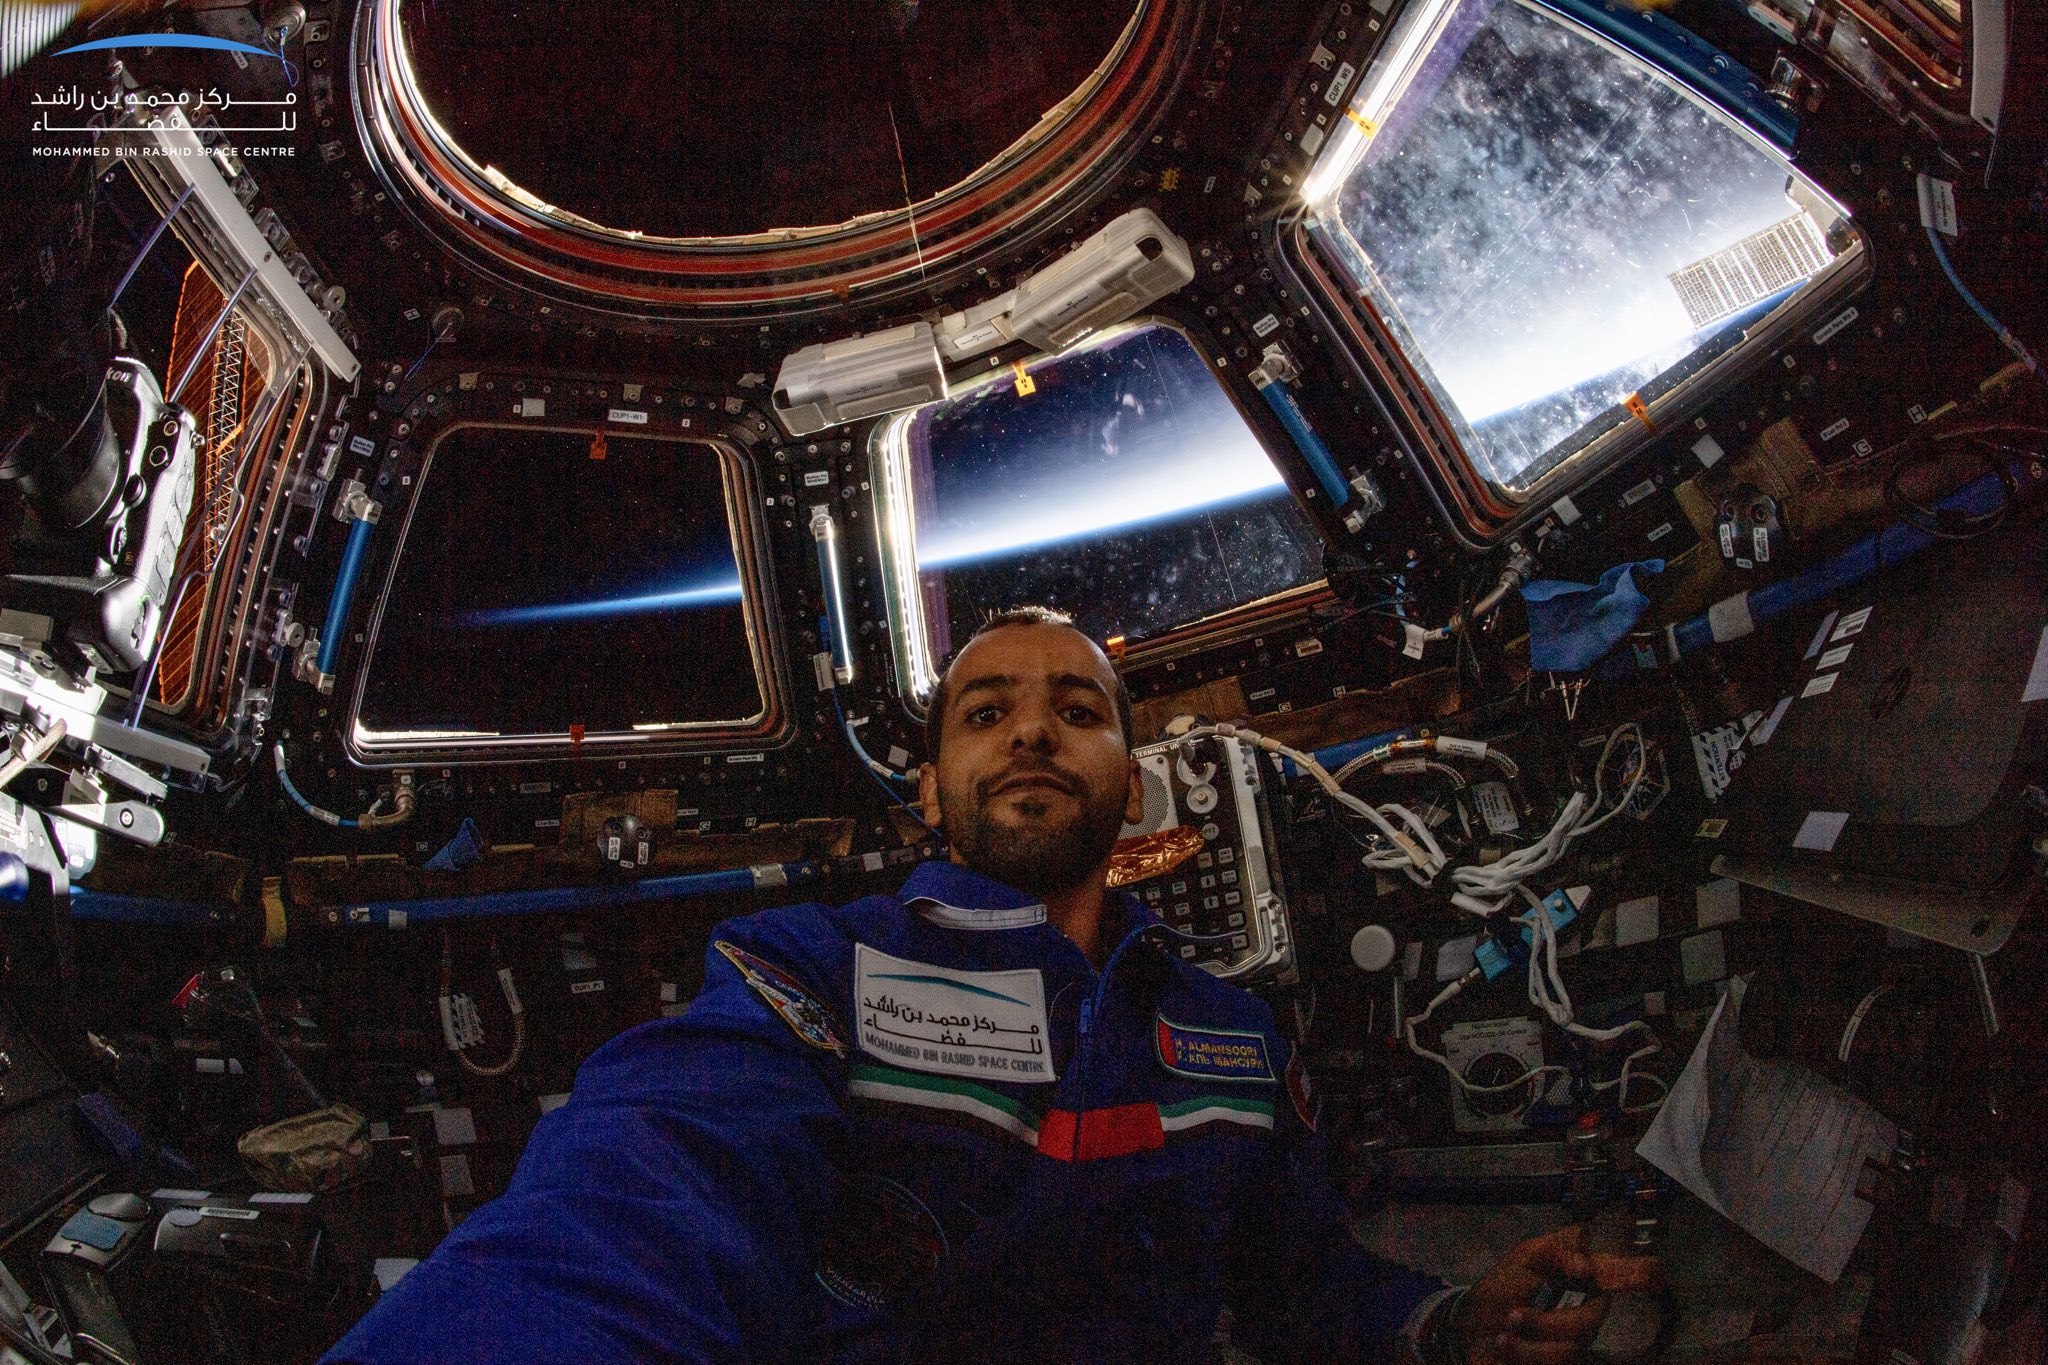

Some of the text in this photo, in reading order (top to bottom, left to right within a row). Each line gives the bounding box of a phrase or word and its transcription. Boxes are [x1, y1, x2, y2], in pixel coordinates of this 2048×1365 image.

[1328, 67, 1351, 101] CUP1_W5
[106, 367, 132, 382] kon
[1856, 441, 1869, 454] G
[1135, 746, 1168, 759] TERMINAL
[864, 995, 1040, 1034] مركز محمد بن راشد
[864, 1013, 1042, 1055] للفضاء
[865, 1031, 1046, 1073] MOHAMMED BIN RASHID SPACE CENTRE
